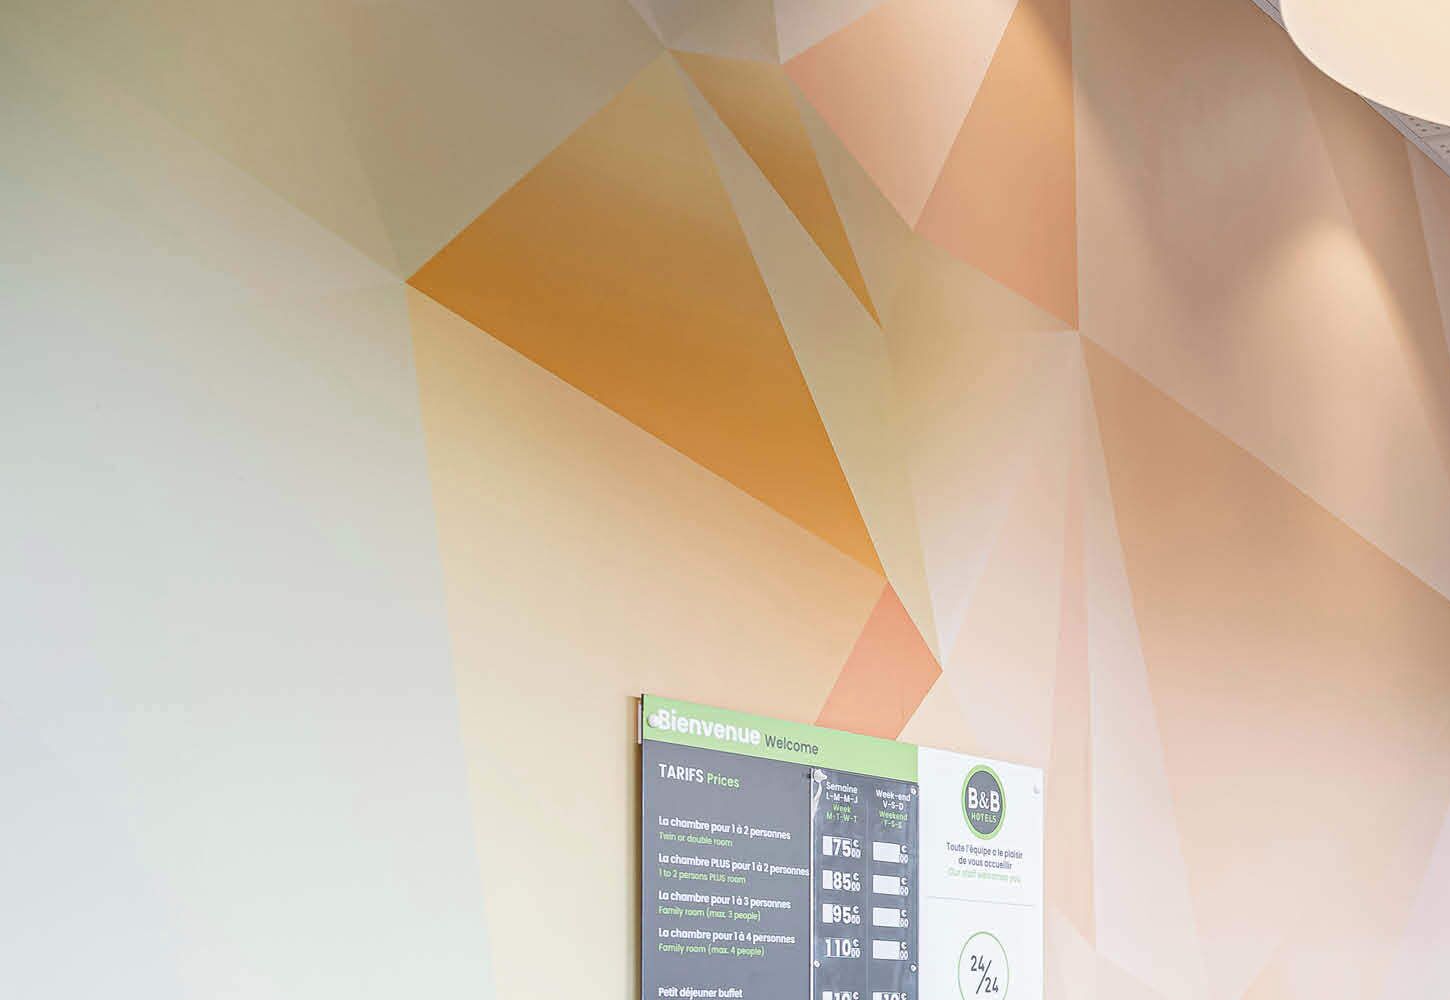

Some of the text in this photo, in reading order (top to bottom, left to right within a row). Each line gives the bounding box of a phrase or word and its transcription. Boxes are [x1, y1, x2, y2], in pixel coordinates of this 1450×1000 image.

[657, 708, 818, 754] Bienvenue Welcome
[659, 764, 740, 788] TARIFS Prices
[826, 782, 857, 793] Semaine
[876, 789, 910, 801] Week-end
[968, 787, 1000, 812] B&B
[833, 804, 851, 813] Week
[971, 812, 996, 823] HOTELS
[659, 816, 791, 840] La chambre pour 1 à 2 personnes
[659, 832, 676, 841] Twin
[687, 834, 712, 844] double
[714, 839, 732, 847] room
[833, 839, 852, 857] 75
[946, 842, 965, 852] Toute
[998, 848, 1003, 856] le
[1005, 849, 1023, 859] plaisir
[659, 853, 809, 876] La chambre PLUS pour 1 à 2 personnes
[673, 870, 677, 878] 2
[679, 872, 708, 881] persons
[710, 873, 725, 881] PLUS
[728, 876, 746, 884] room
[834, 872, 851, 890] 85
[659, 891, 791, 909] La chambre pour 1 à 3 personnes
[659, 906, 683, 917] Family
[734, 911, 760, 921] people)
[833, 905, 851, 924] 95
[659, 928, 795, 944] La chambre pour 1 à 4 personnes
[659, 943, 684, 955] Family
[686, 945, 706, 953] room
[737, 947, 765, 957] people)
[825, 939, 850, 957] 110
[658, 987, 742, 1000] Petit déjeuner buffet
